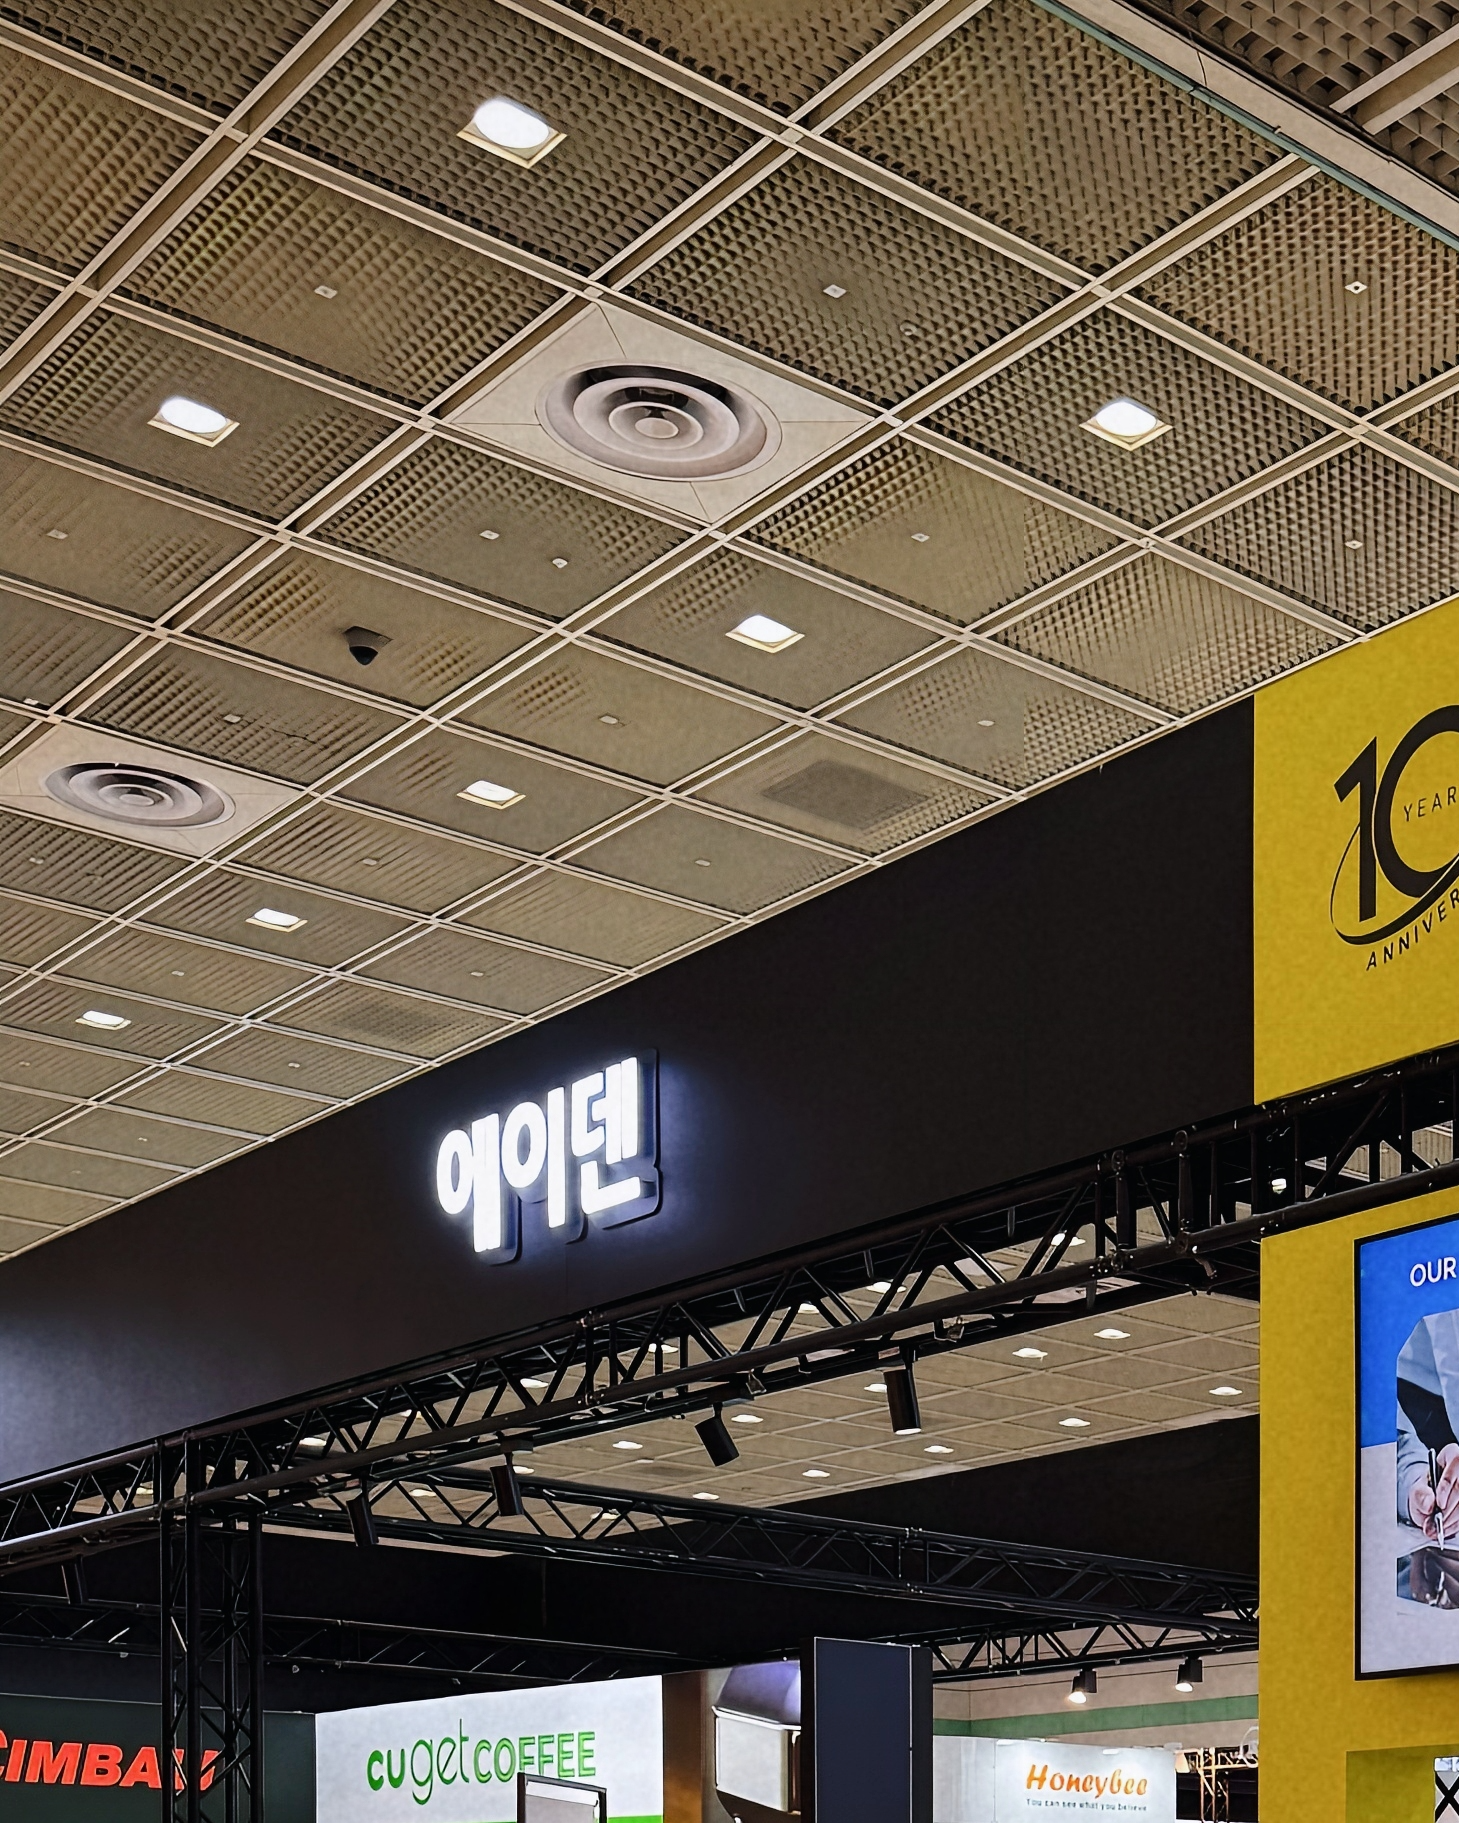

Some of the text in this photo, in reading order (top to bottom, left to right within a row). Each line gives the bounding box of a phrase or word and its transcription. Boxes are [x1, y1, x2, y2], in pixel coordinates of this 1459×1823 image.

[436, 1056, 641, 1253] 에이덴
[1409, 1256, 1457, 1288] OUR
[1026, 1764, 1148, 1799] Honeybee
